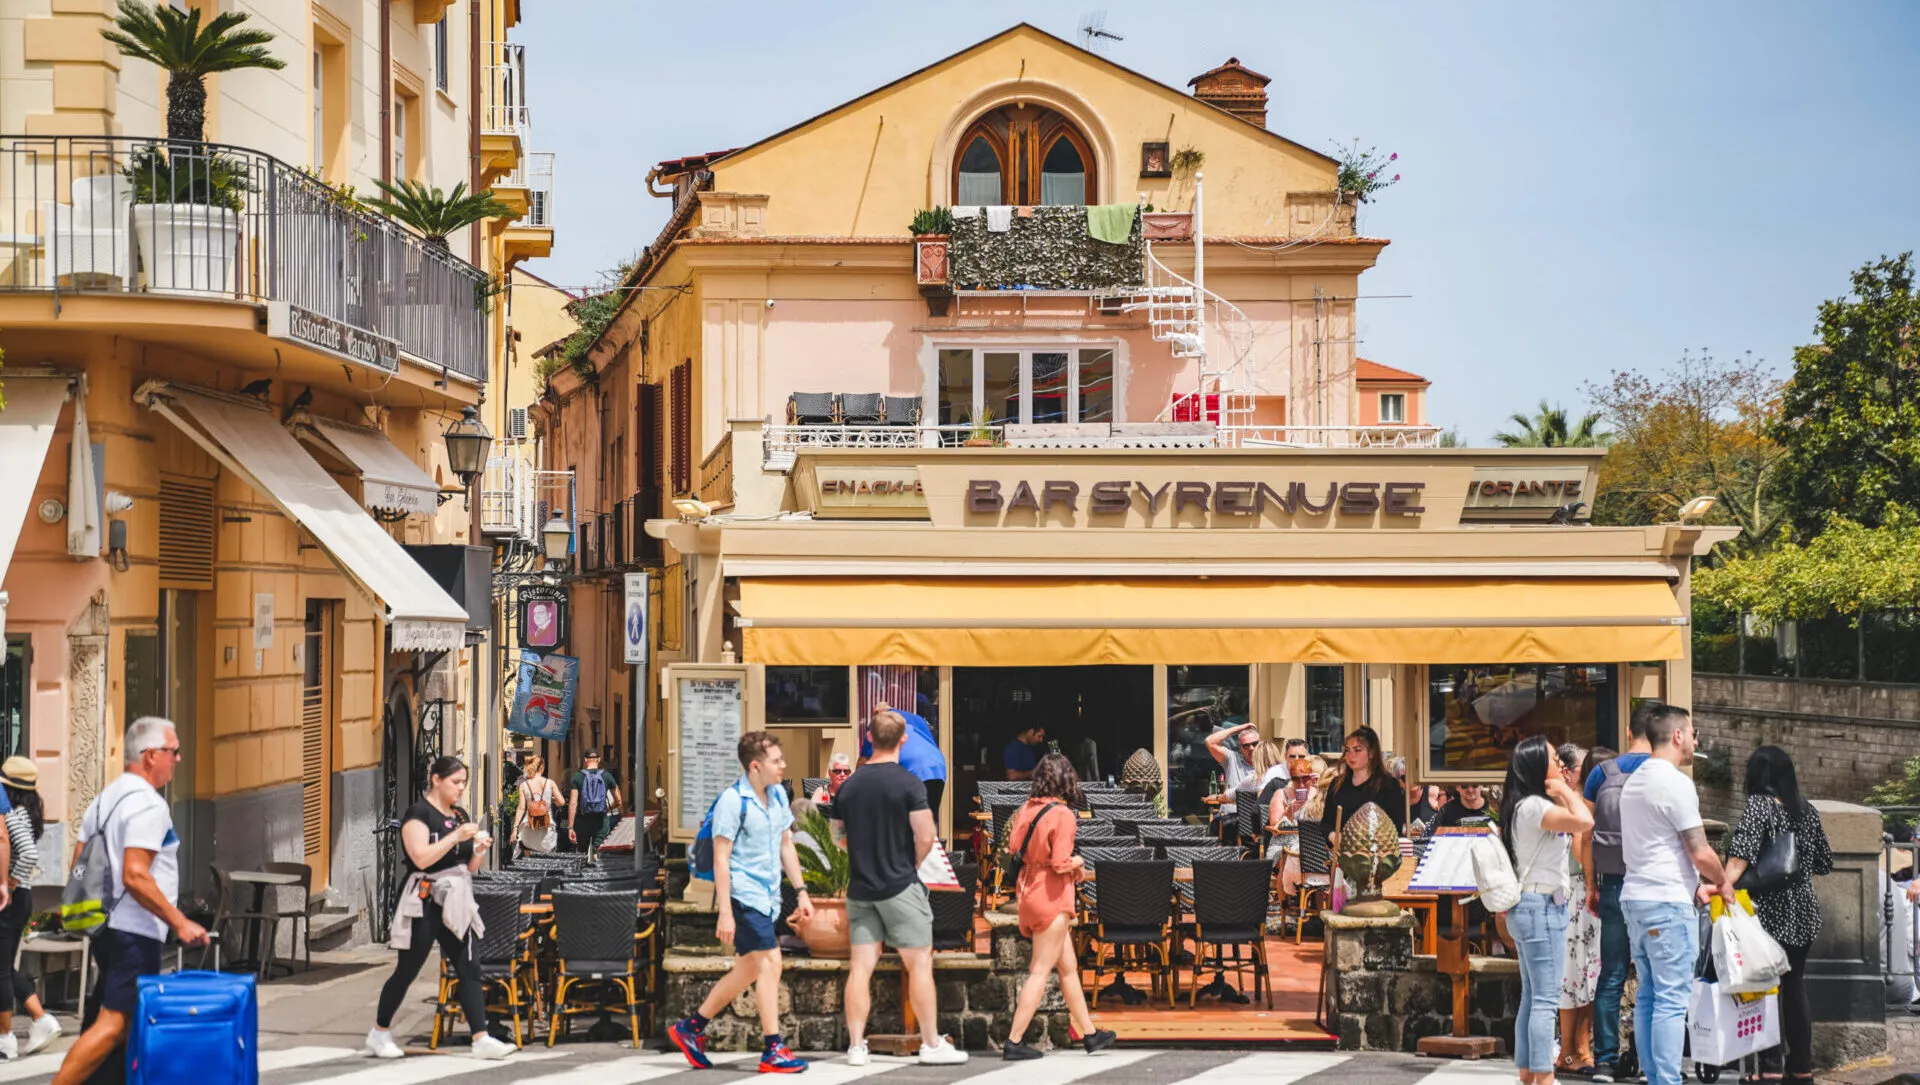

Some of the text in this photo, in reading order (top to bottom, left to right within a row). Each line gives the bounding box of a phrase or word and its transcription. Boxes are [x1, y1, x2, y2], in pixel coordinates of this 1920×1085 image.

[291, 310, 341, 350] Ristorante
[346, 331, 377, 362] Caruso
[968, 479, 1426, 517] BAR SYRENUSE
[519, 586, 567, 602] Ristorante
